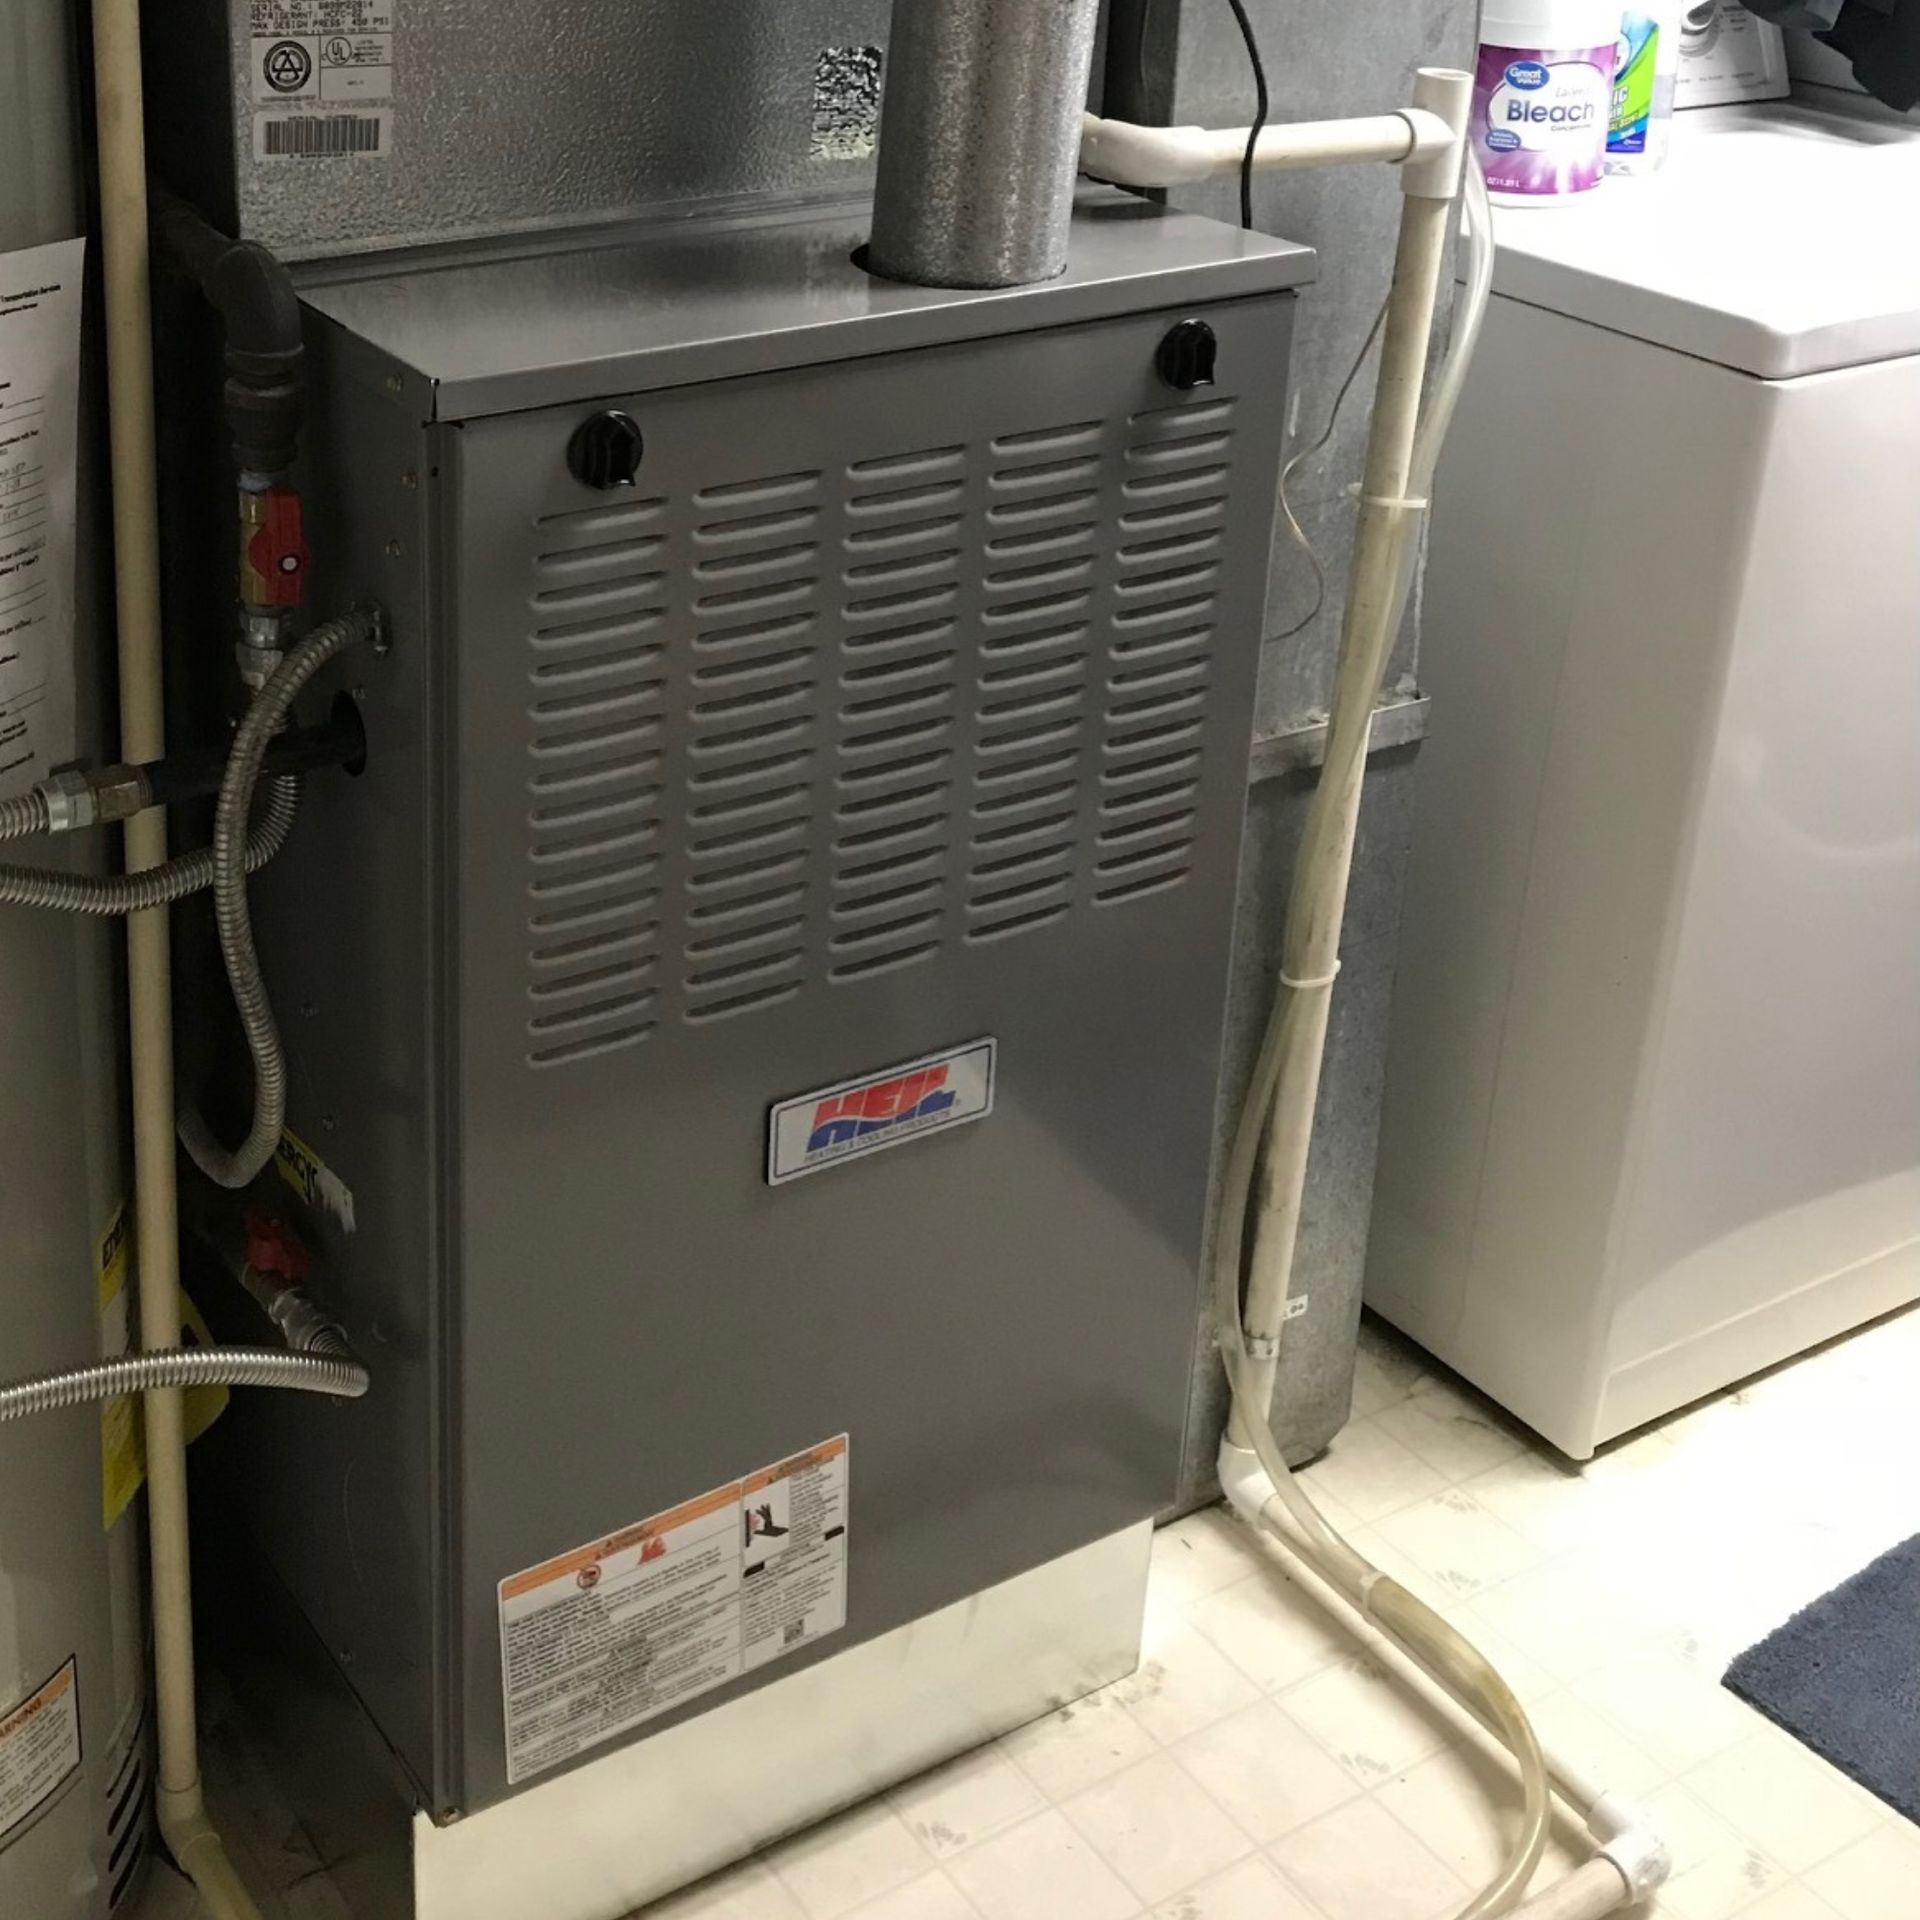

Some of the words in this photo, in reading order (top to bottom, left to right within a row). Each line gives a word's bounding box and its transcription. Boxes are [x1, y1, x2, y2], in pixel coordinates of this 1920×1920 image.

[1509, 67, 1543, 79] Great
[1515, 76, 1542, 86] Value
[1506, 99, 1595, 123] Bleach
[807, 1063, 956, 1153] HEIL
[0, 1696, 42, 1739] ARNING
